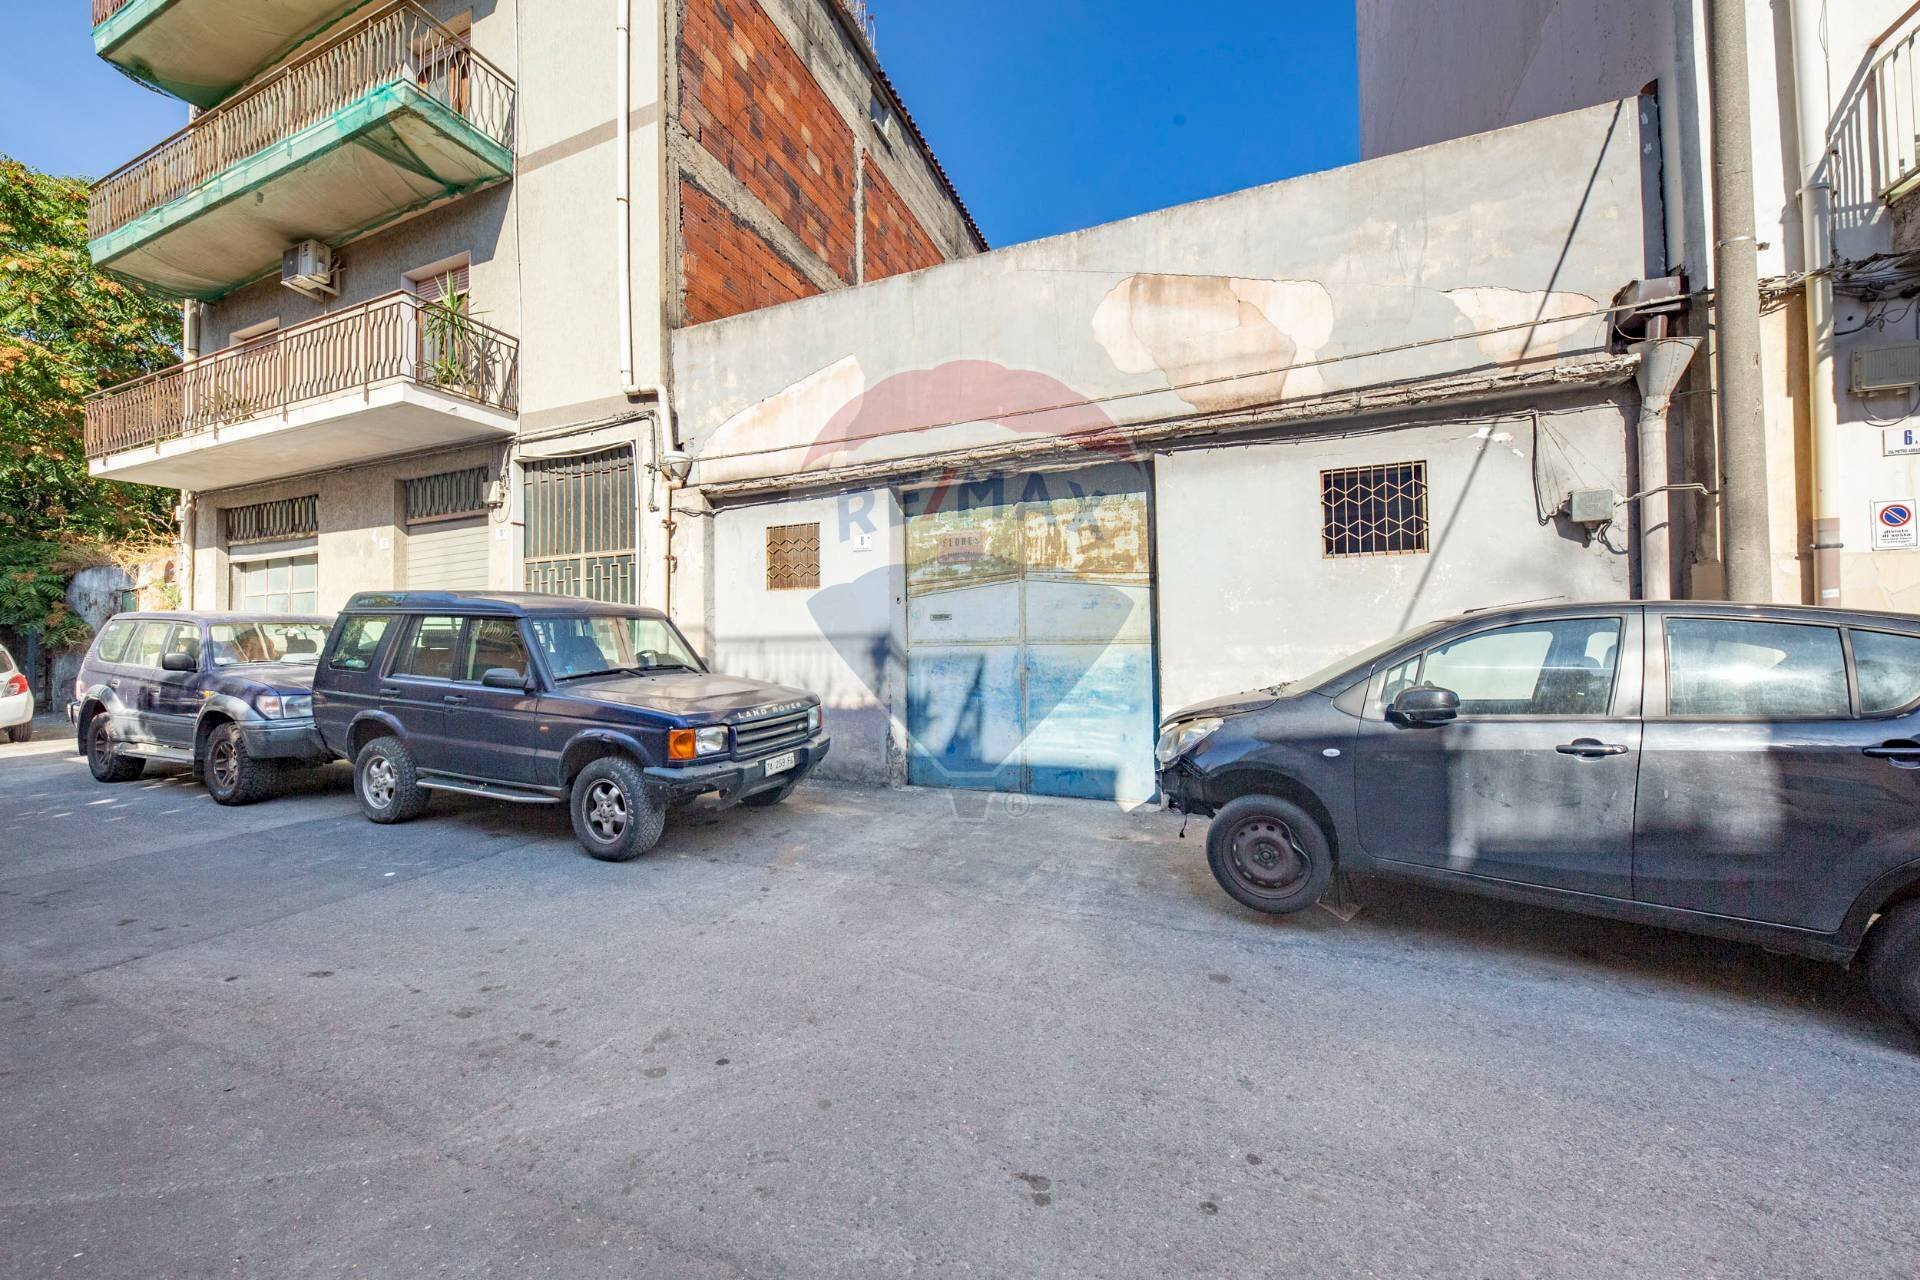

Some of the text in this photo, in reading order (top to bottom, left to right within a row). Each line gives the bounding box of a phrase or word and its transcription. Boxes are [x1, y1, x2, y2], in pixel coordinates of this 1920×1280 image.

[1904, 430, 1912, 445] 6
[737, 702, 801, 719] LAND ROVER
